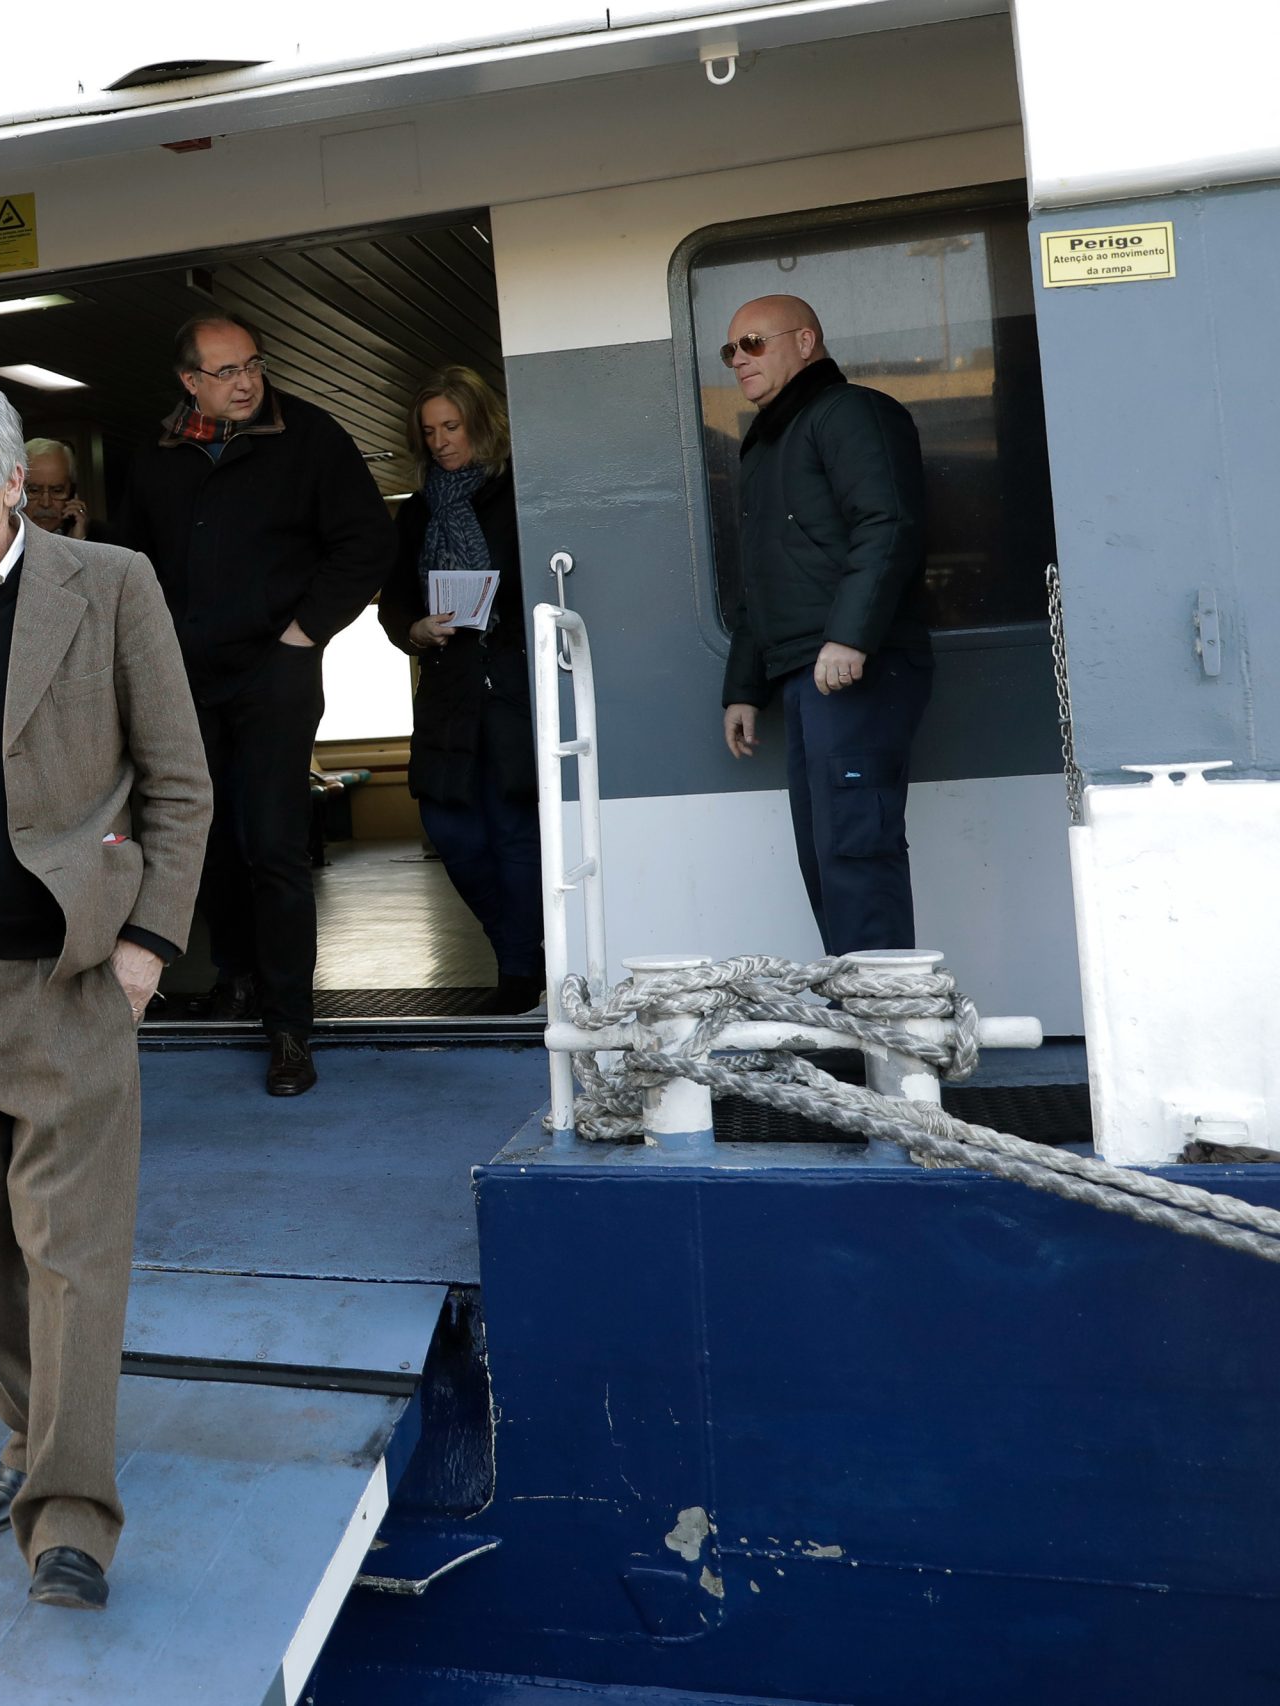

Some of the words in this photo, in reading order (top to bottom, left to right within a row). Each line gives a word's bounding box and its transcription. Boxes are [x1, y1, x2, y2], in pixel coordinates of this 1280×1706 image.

[1069, 236, 1143, 251] Perigo
[1053, 254, 1093, 264] Atenção
[1096, 252, 1108, 260] ao
[1111, 247, 1165, 260] movimento
[1086, 267, 1099, 275] da
[1101, 265, 1132, 274] rampa
